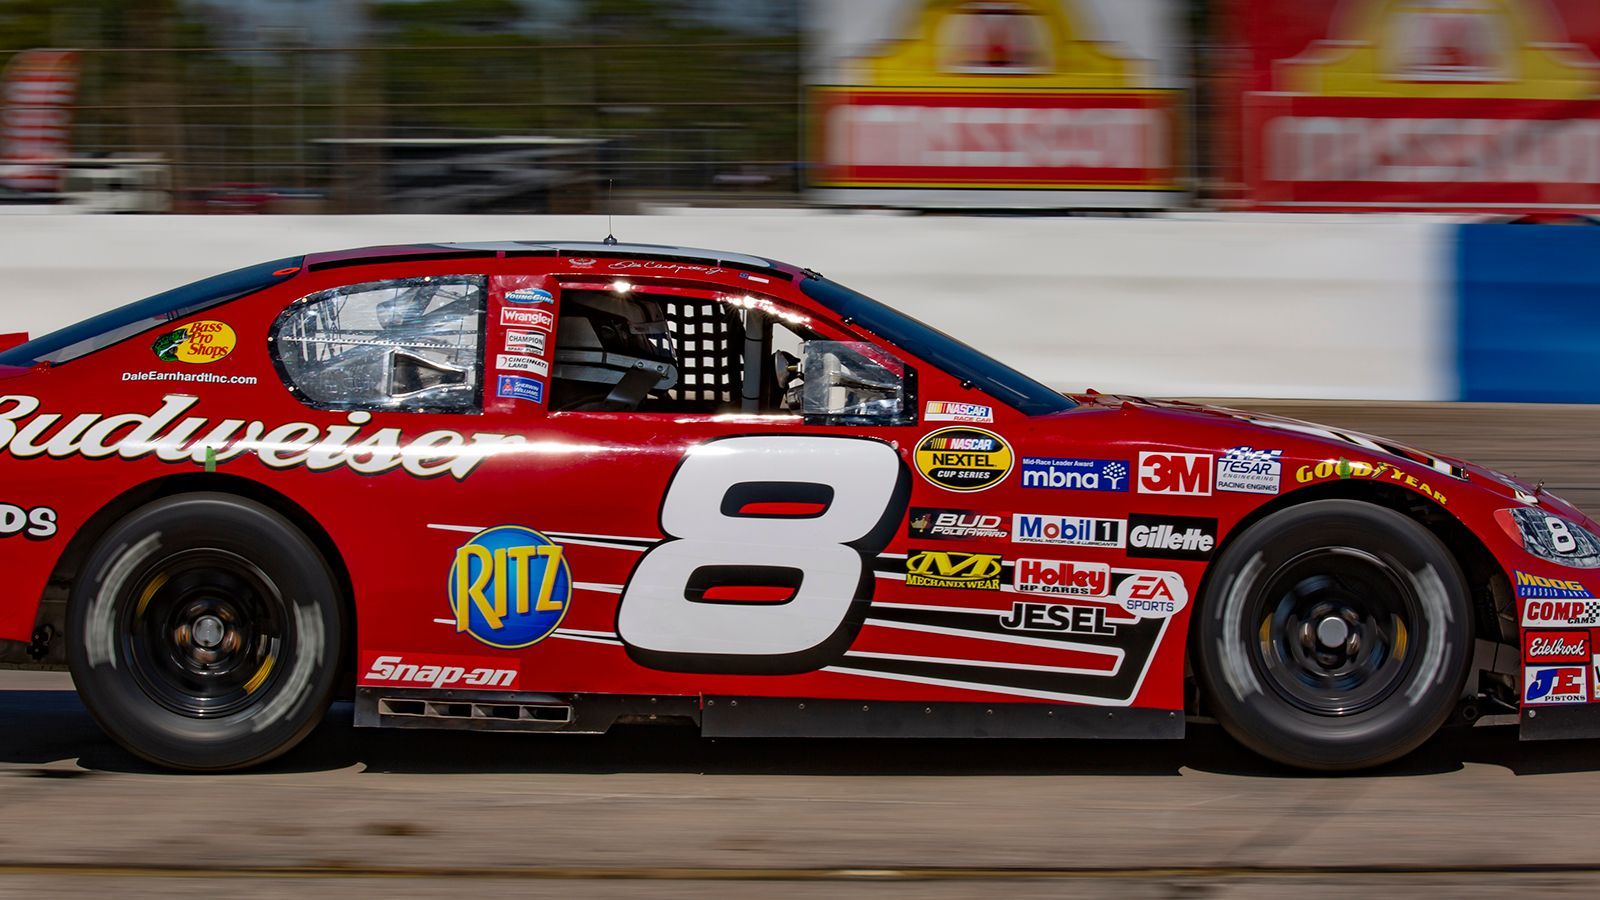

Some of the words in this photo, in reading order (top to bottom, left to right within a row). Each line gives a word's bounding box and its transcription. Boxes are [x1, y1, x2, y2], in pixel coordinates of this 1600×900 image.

[505, 310, 551, 327] Wrangler
[189, 322, 223, 333] Bass
[188, 332, 213, 343] Pro
[508, 335, 543, 345] CHAMPION
[187, 343, 228, 358] Shops
[508, 357, 547, 369] CINCINNATI
[122, 371, 257, 384] DaleEarnhardtInc.com
[946, 403, 986, 417] NASCAR
[0, 393, 527, 479] Budweiser
[950, 438, 993, 451] NASCAR
[932, 453, 994, 467] NEXTEL
[1219, 460, 1272, 475] TESAR
[937, 470, 957, 478] CUP
[958, 471, 991, 479] SERIES
[1023, 466, 1099, 488] mbna
[1141, 454, 1211, 493] 3M
[1222, 473, 1274, 482] ENGINEERING
[1218, 481, 1245, 489] RACING
[1246, 482, 1277, 491] ENGINES
[935, 513, 1002, 528] BUD
[1020, 516, 1091, 540] Mobil
[1101, 521, 1112, 541] 1
[1130, 524, 1214, 552] Gillette
[1544, 516, 1577, 552] 8
[614, 433, 907, 664] 8
[906, 573, 965, 588] MECHANIX
[967, 579, 1000, 590] WEAR
[1020, 560, 1105, 595] Holley
[1516, 570, 1584, 591] MOOG
[456, 544, 563, 632] RITZ
[1020, 584, 1040, 592] HP
[1042, 586, 1089, 594] CARBS
[1129, 576, 1175, 601] EA
[1127, 600, 1174, 613] SPORTS
[1527, 601, 1585, 621] COMP
[1001, 602, 1116, 635] JESEL
[1567, 616, 1597, 624] CAMS
[1529, 637, 1585, 656] Edelbrock
[364, 656, 518, 688] Snap-on
[1527, 668, 1583, 701] JE
